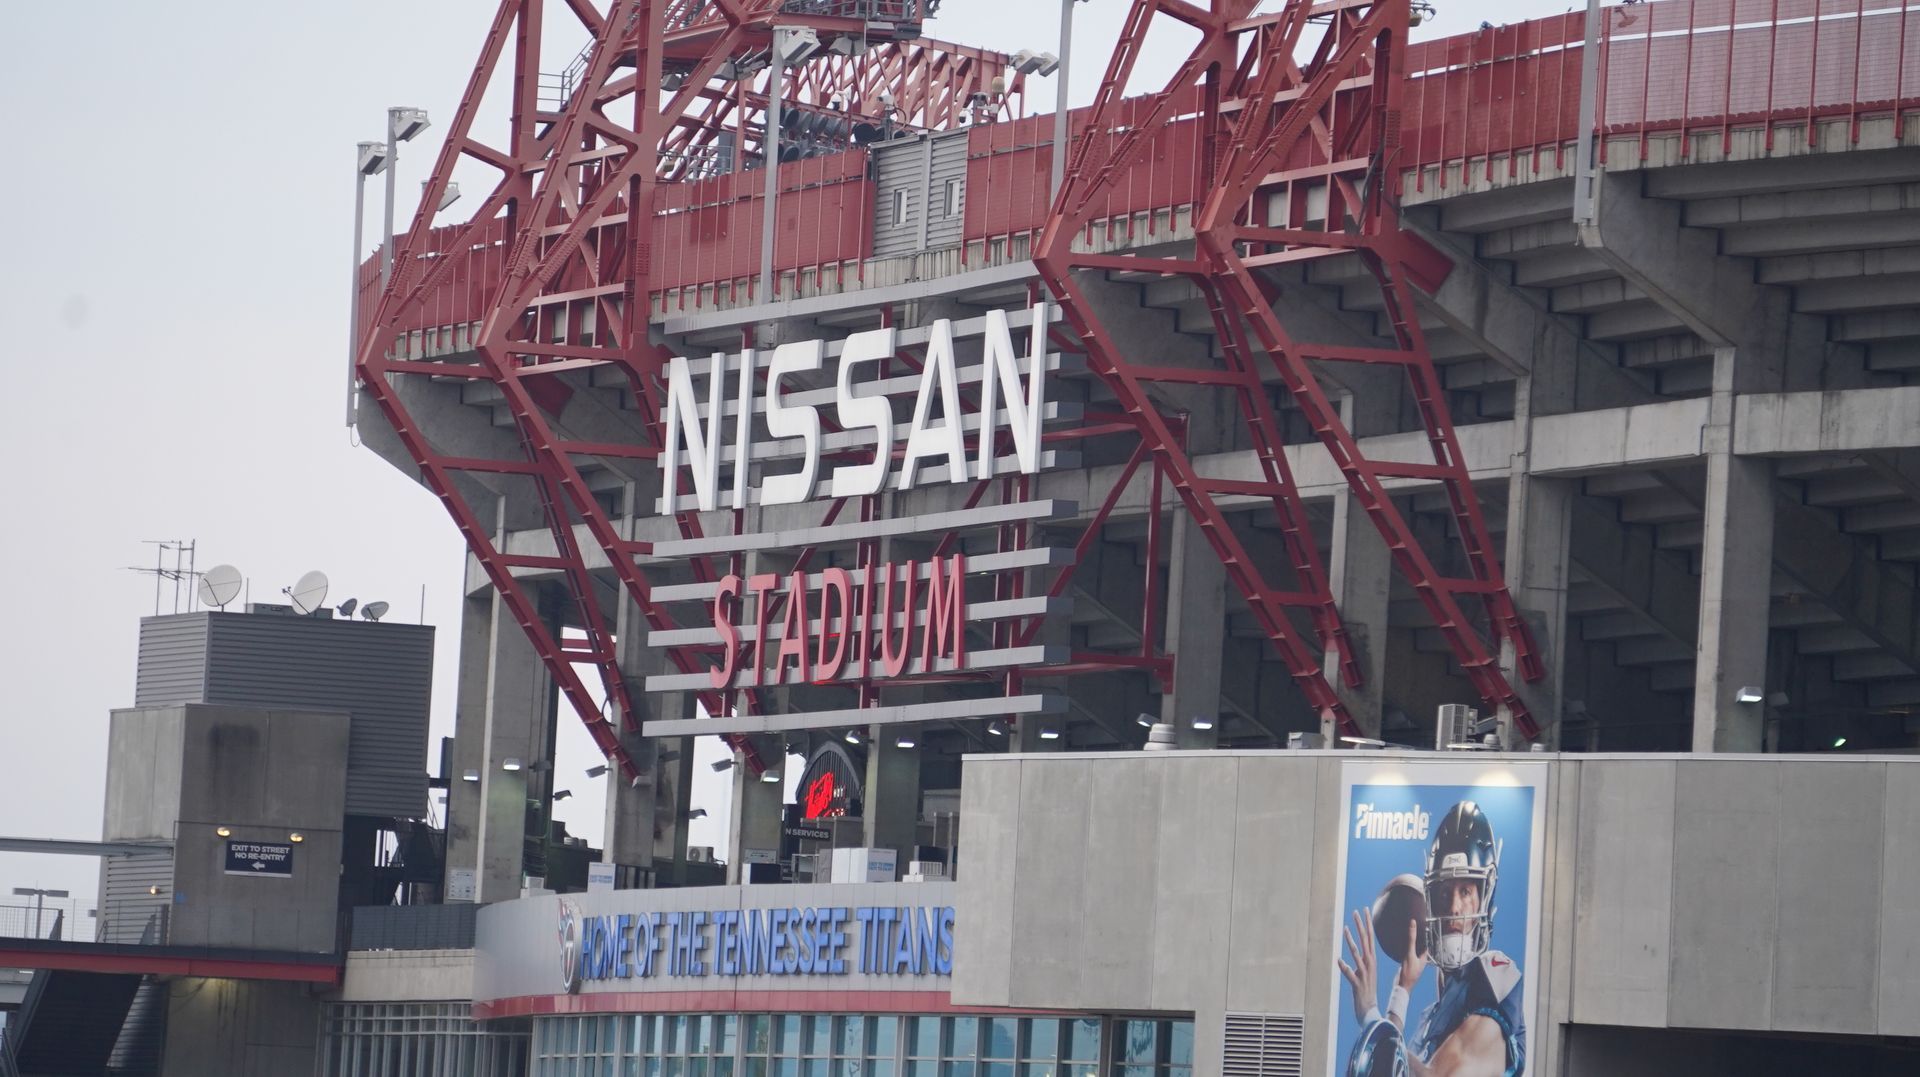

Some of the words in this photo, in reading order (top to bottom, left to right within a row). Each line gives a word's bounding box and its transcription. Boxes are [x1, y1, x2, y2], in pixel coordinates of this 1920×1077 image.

[662, 302, 1048, 515] NISSAN
[710, 553, 965, 689] STADIUM
[792, 828, 829, 838] SERVICES
[1355, 802, 1429, 840] Pinnacle
[231, 844, 248, 852] EXIT
[261, 846, 290, 854] STREET
[247, 853, 286, 861] RE-ENTRY
[580, 914, 631, 981] HOME
[634, 911, 664, 978] OF
[667, 911, 707, 977] THE
[713, 907, 848, 976] TENNESSEE
[856, 905, 955, 976] TITANS
